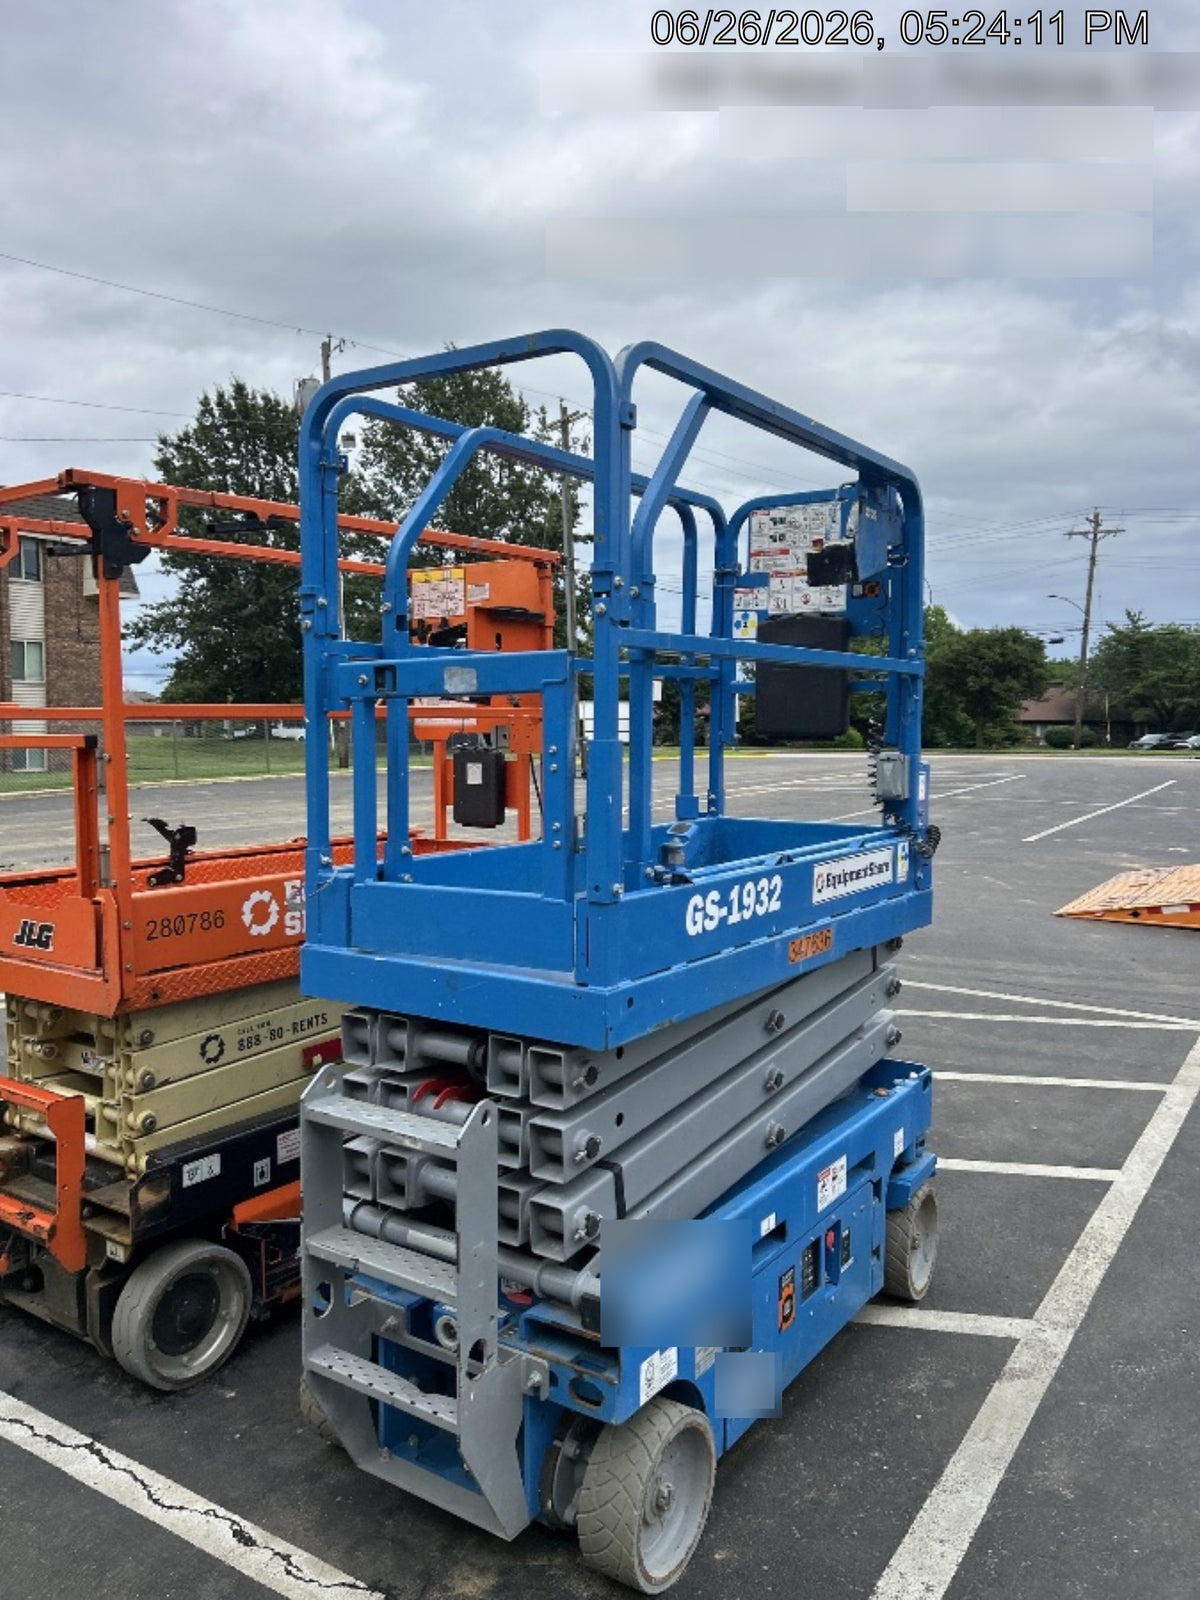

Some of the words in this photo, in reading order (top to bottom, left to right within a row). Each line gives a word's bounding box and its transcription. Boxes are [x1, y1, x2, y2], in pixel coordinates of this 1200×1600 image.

[686, 874, 783, 936] GS-1932
[13, 919, 56, 951] JLG
[146, 909, 225, 941] 280786
